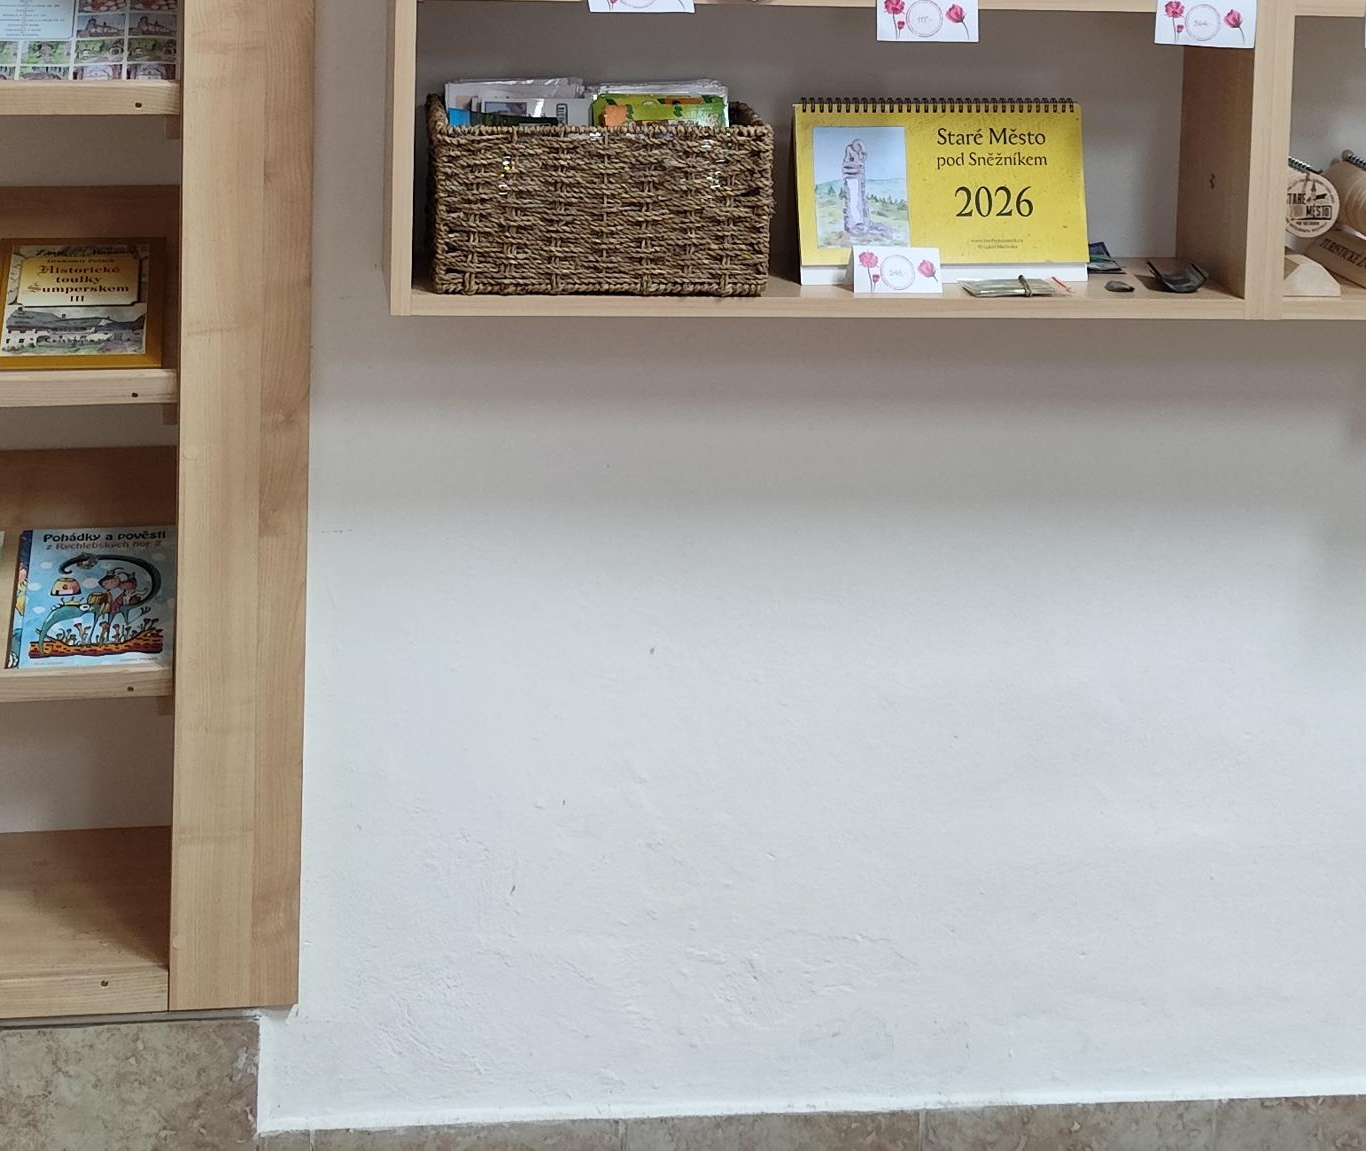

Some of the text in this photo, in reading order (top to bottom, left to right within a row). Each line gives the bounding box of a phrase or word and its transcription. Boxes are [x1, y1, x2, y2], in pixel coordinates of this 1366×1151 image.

[937, 128, 1046, 145] Staré Město
[937, 152, 1047, 170] pod Sněžníkem
[955, 186, 1033, 217] 2026
[1287, 192, 1306, 205] TARÉ
[38, 265, 121, 274] Historické
[56, 275, 102, 283] toulky
[27, 283, 130, 293] Šumperskem
[43, 533, 101, 543] Pohádky
[118, 531, 166, 541] pověsti
[56, 541, 130, 550] Rychlebských
[132, 541, 151, 549] hor
